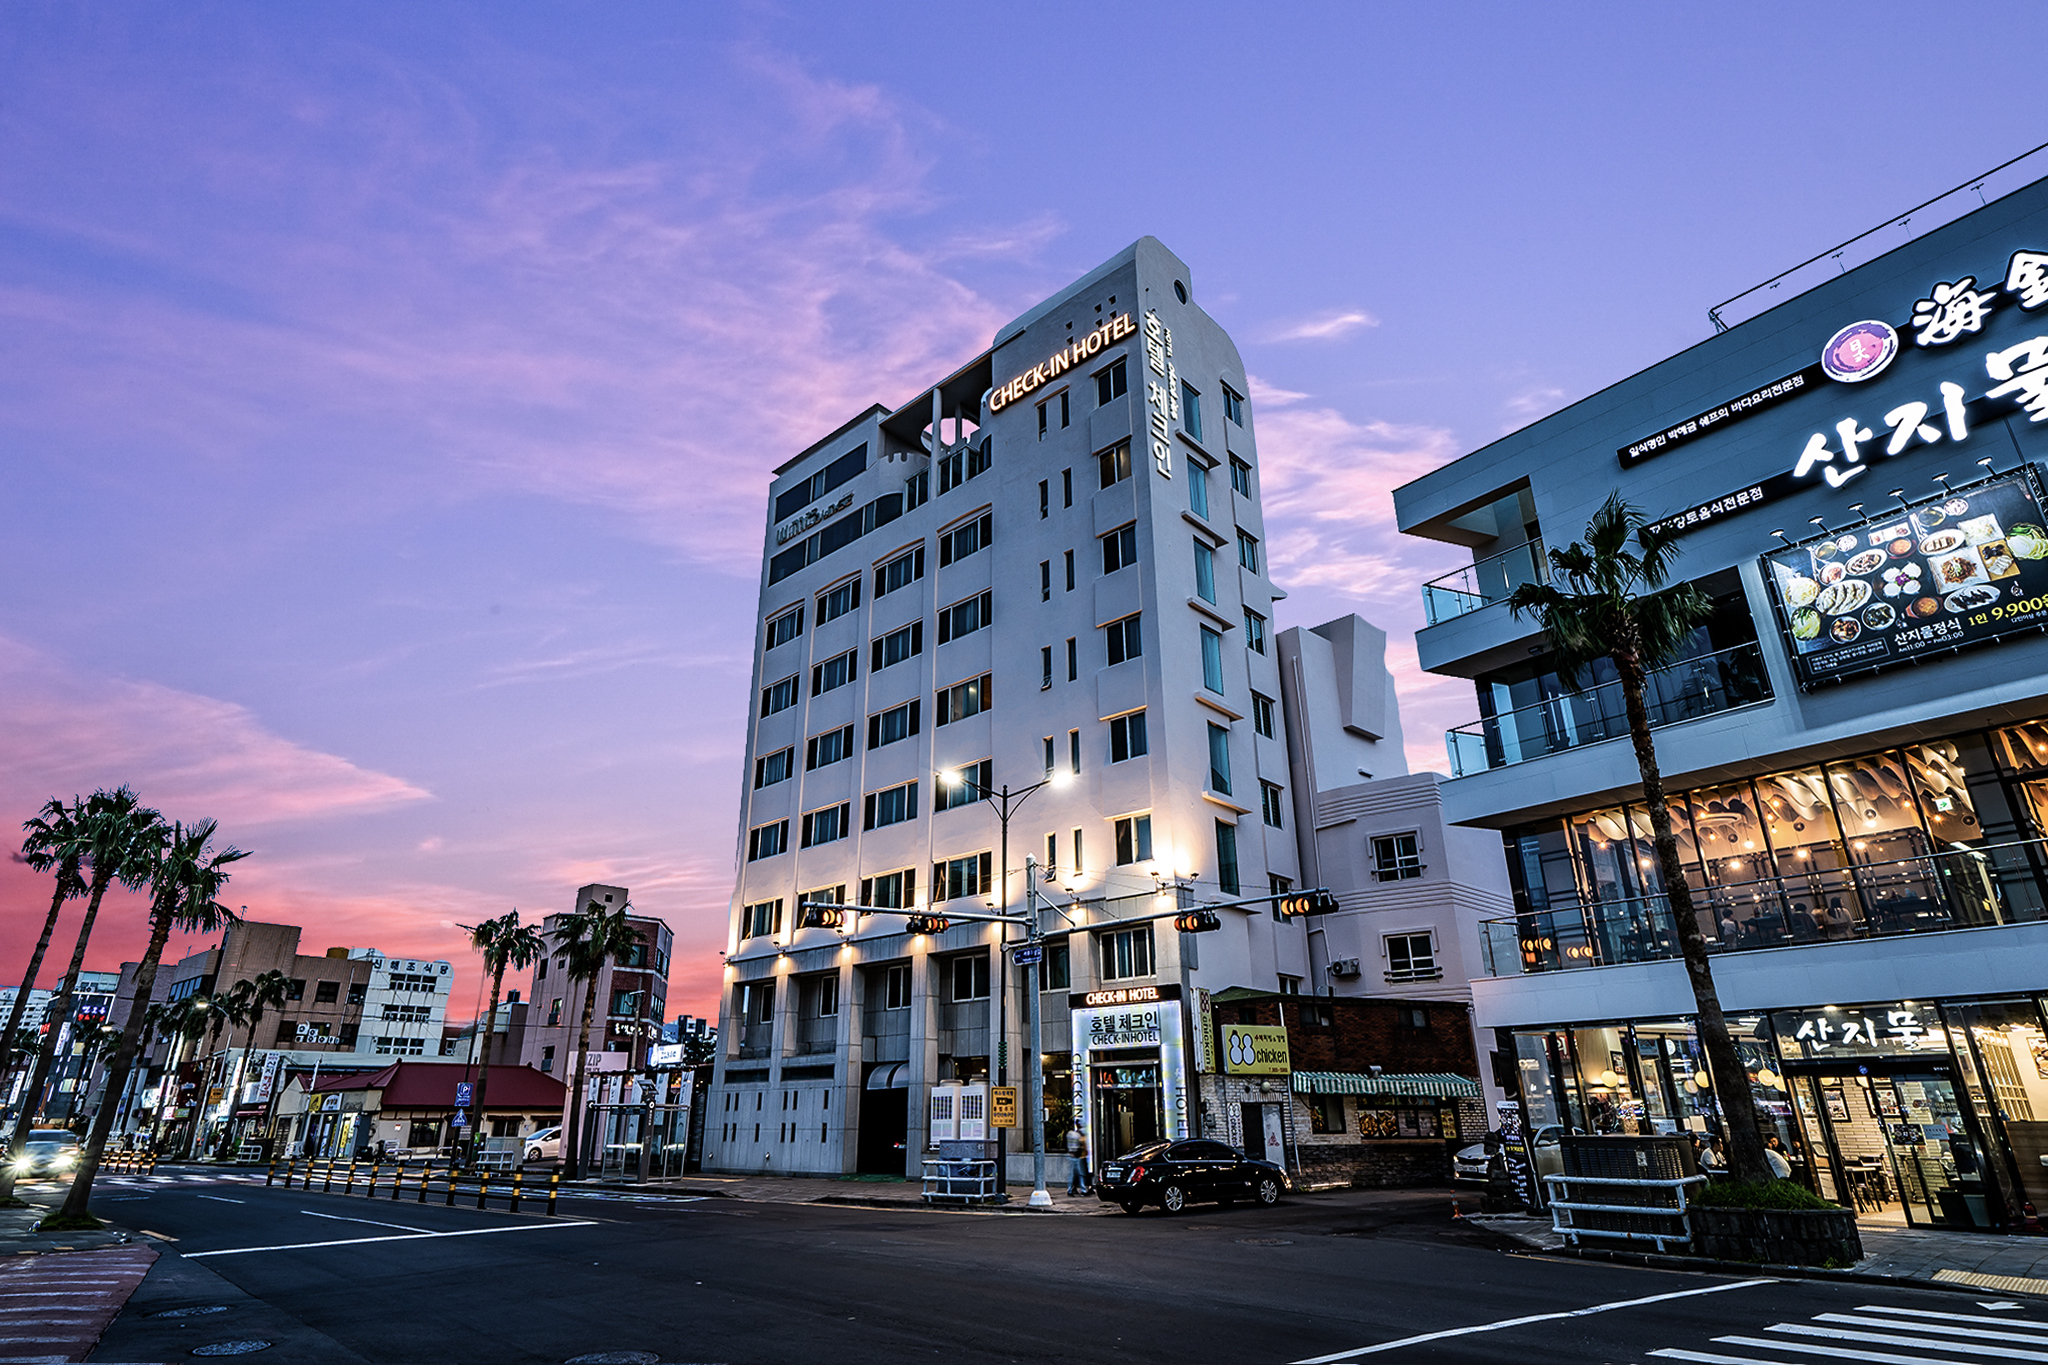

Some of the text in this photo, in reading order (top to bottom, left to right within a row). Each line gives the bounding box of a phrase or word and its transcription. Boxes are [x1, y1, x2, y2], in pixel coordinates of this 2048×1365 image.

[989, 313, 1136, 412] CHECK-IN HOTEL
[1144, 311, 1172, 479] 호텔 체크인
[1629, 434, 1667, 458] 일식명인
[1731, 375, 1805, 412] 바다요리전문점
[1894, 617, 1962, 646] 산지물정식
[1086, 987, 1159, 1005] CHECK-IN HOTEL
[1090, 1011, 1158, 1033] 호텔 체크인
[1796, 1011, 1923, 1051] 산지물
[1256, 1048, 1288, 1064] chicken
[1175, 1087, 1188, 1137] HOTEL
